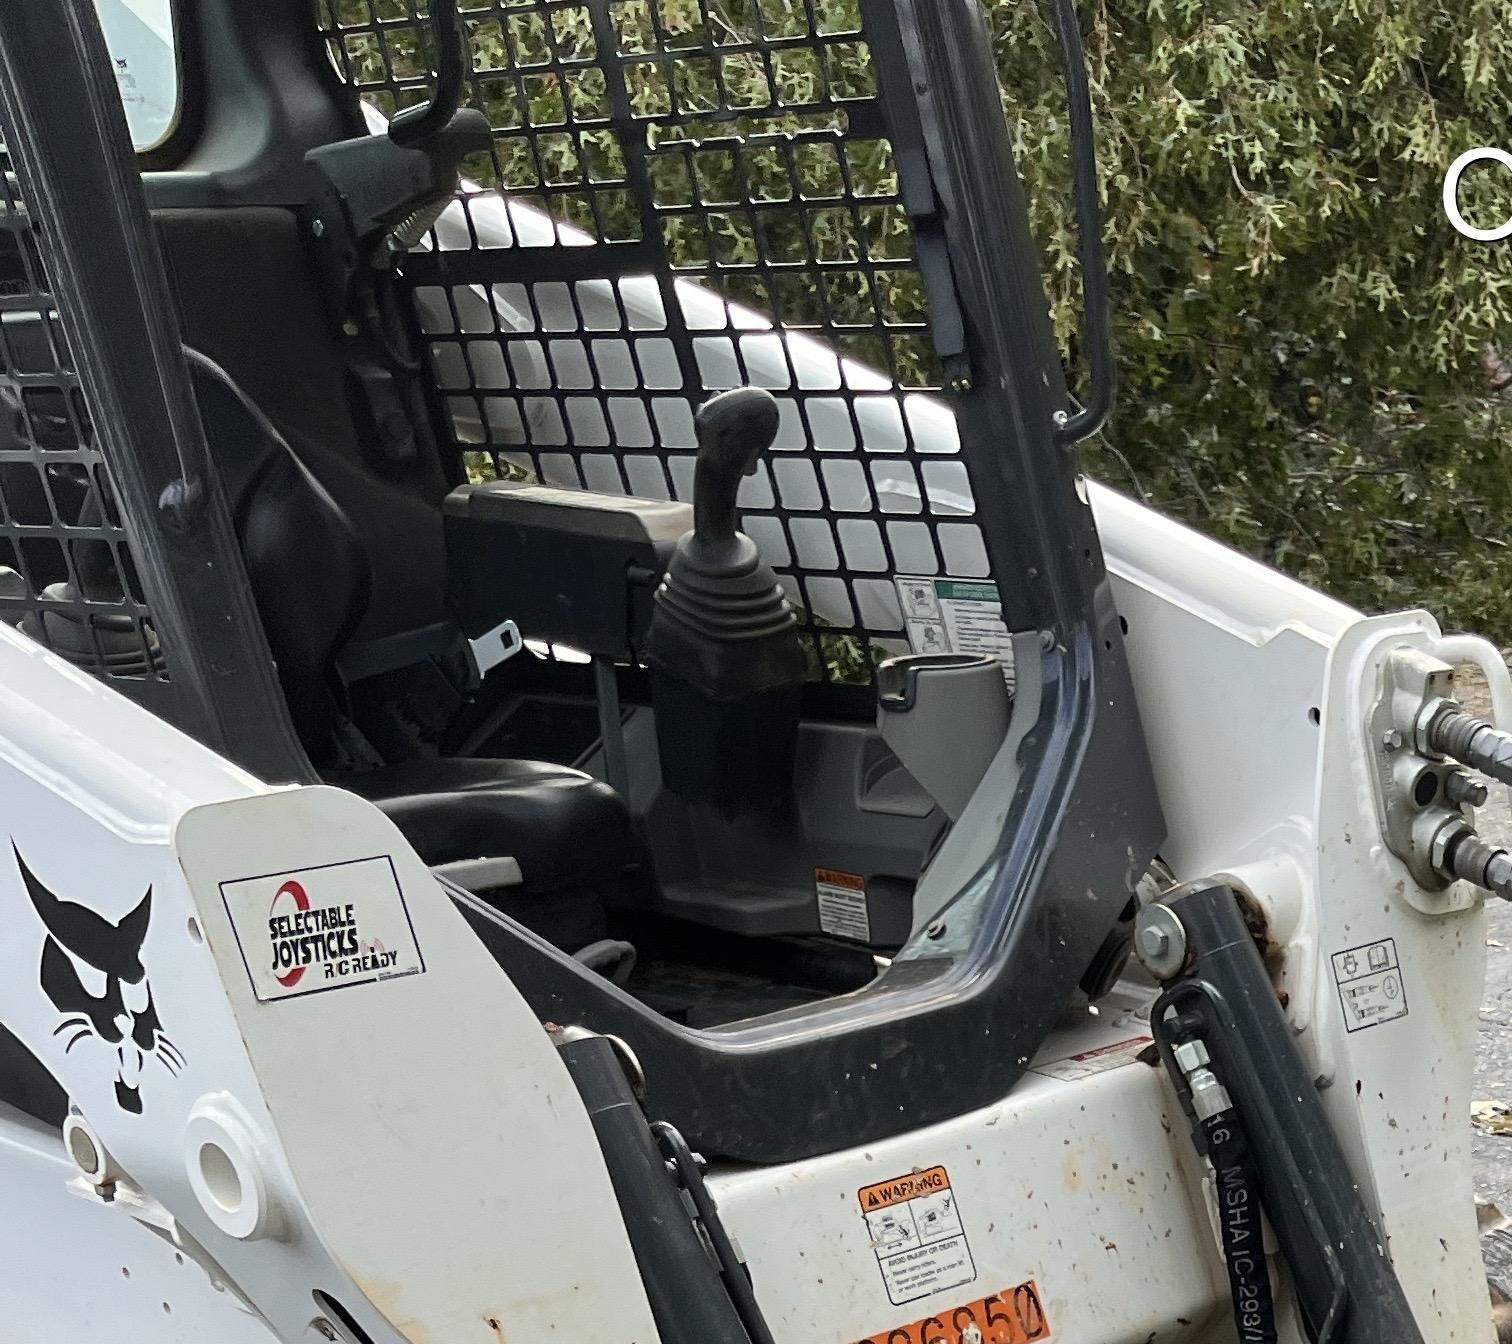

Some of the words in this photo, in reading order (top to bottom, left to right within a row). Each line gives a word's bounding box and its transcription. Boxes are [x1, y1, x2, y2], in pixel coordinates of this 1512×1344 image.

[269, 904, 356, 940] SELECTABLE
[272, 928, 359, 970] JOYSTICKS
[1221, 1165, 1250, 1243] MSHA
